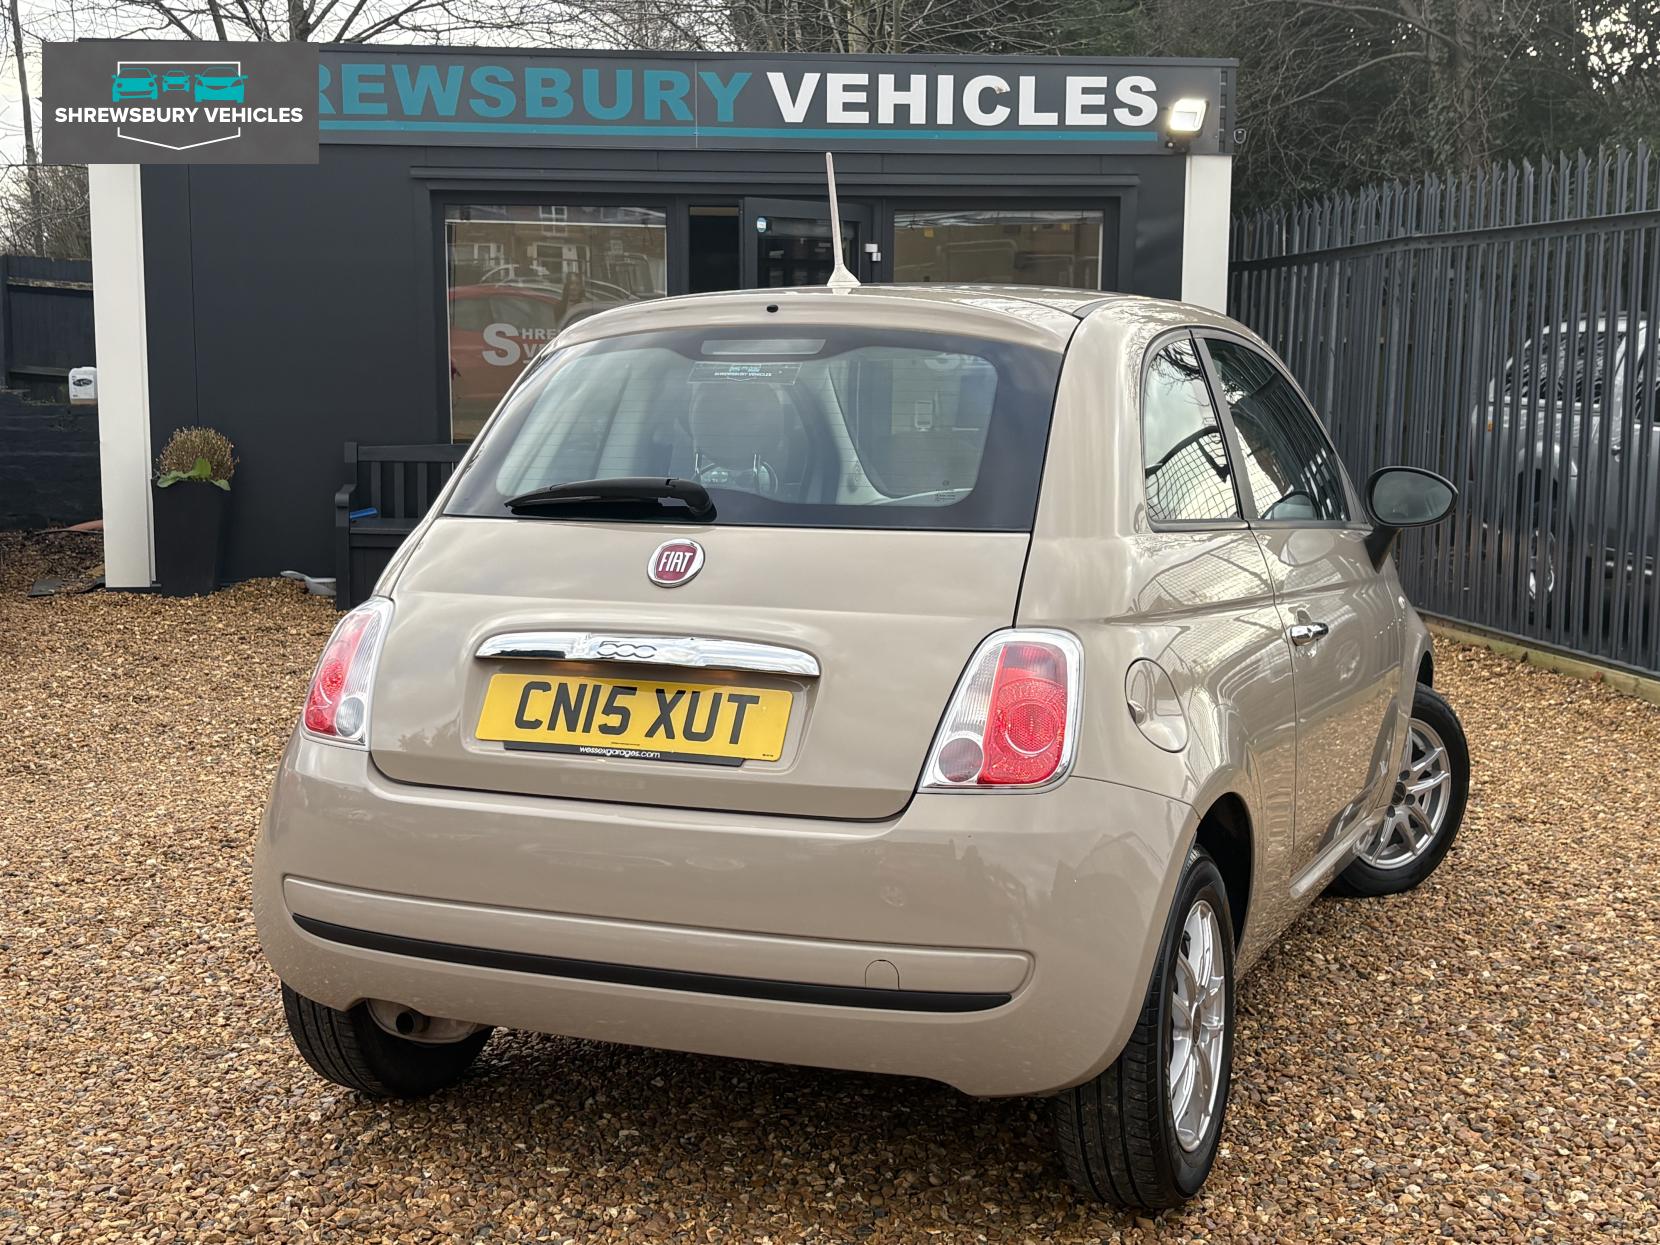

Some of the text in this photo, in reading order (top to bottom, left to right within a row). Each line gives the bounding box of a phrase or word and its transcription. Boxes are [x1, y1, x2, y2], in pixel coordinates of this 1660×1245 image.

[766, 72, 1158, 127] VEHICLES
[658, 551, 694, 573] FIAT
[596, 640, 658, 659] 500
[514, 680, 760, 745] CN15 XUT
[579, 746, 661, 758] wessexgarages.com
